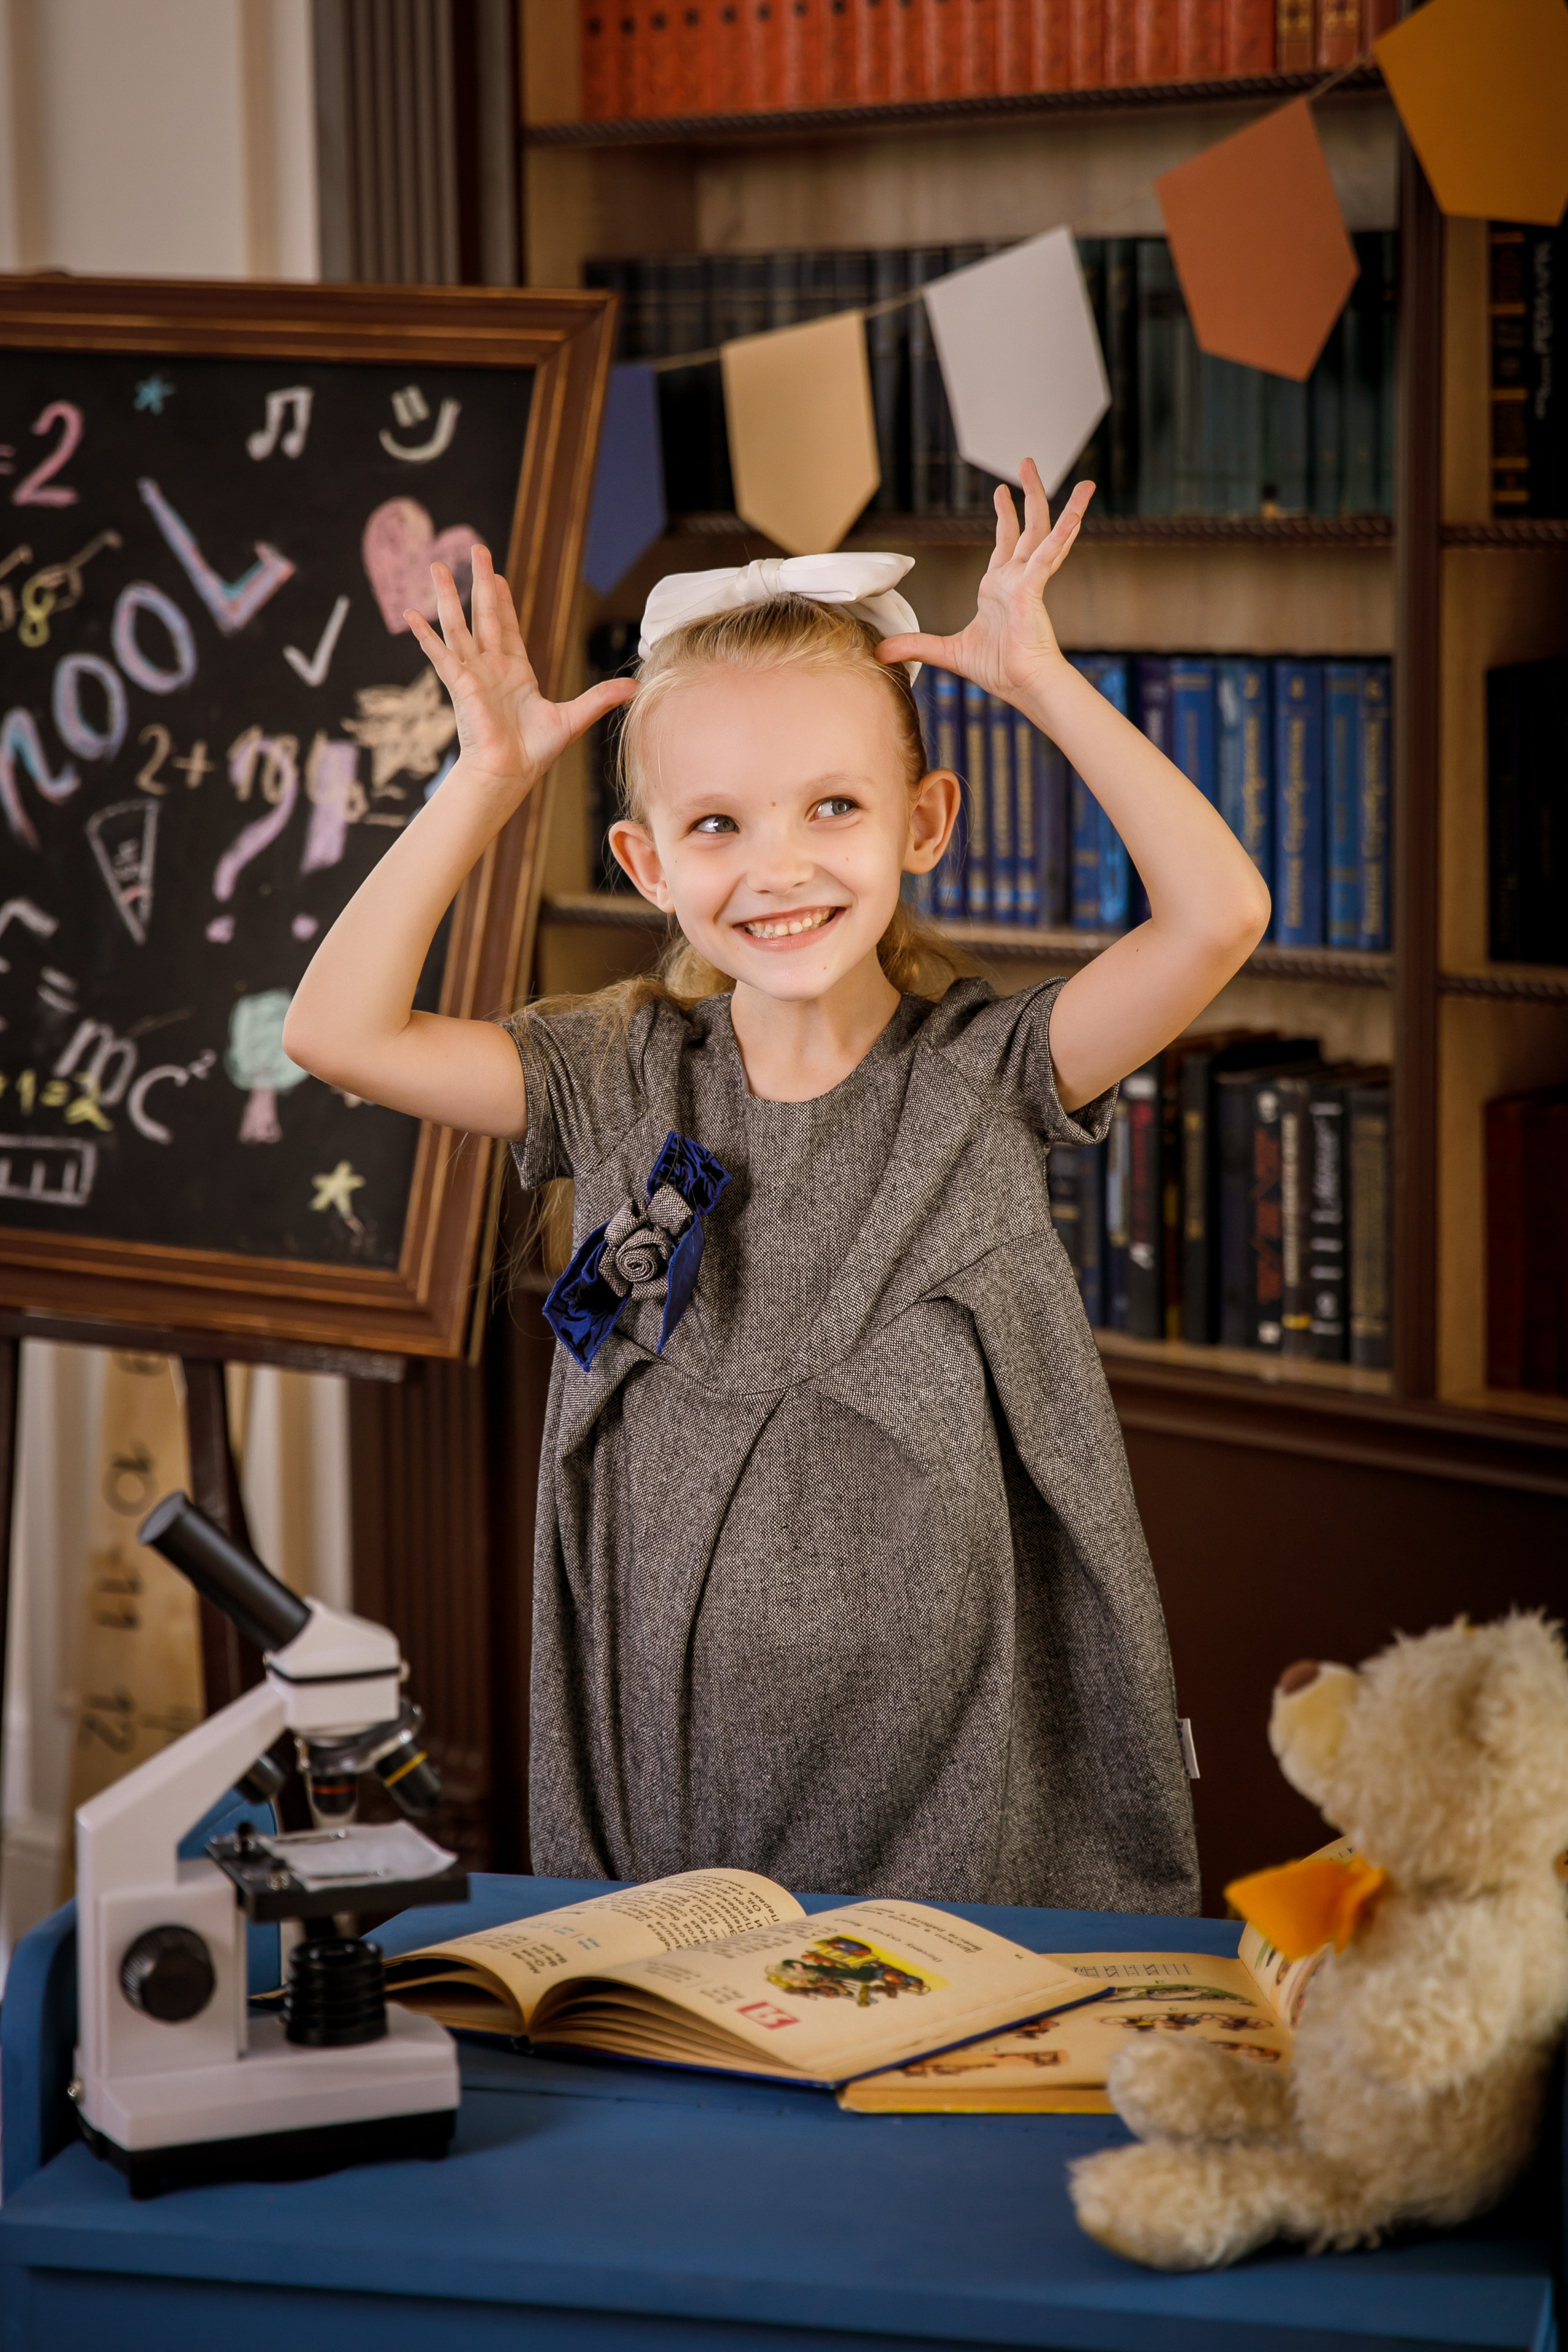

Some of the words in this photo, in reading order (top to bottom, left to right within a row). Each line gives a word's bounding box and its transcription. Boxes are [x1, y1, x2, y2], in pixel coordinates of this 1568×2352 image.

[726, 1886, 743, 1895] как
[692, 1904, 718, 1924] Петя!
[704, 1889, 754, 1930] Прибежали
[733, 1896, 753, 1914] всем
[749, 1891, 780, 1922] Первая
[689, 1907, 707, 1924] есть
[715, 1902, 746, 1933] Первая
